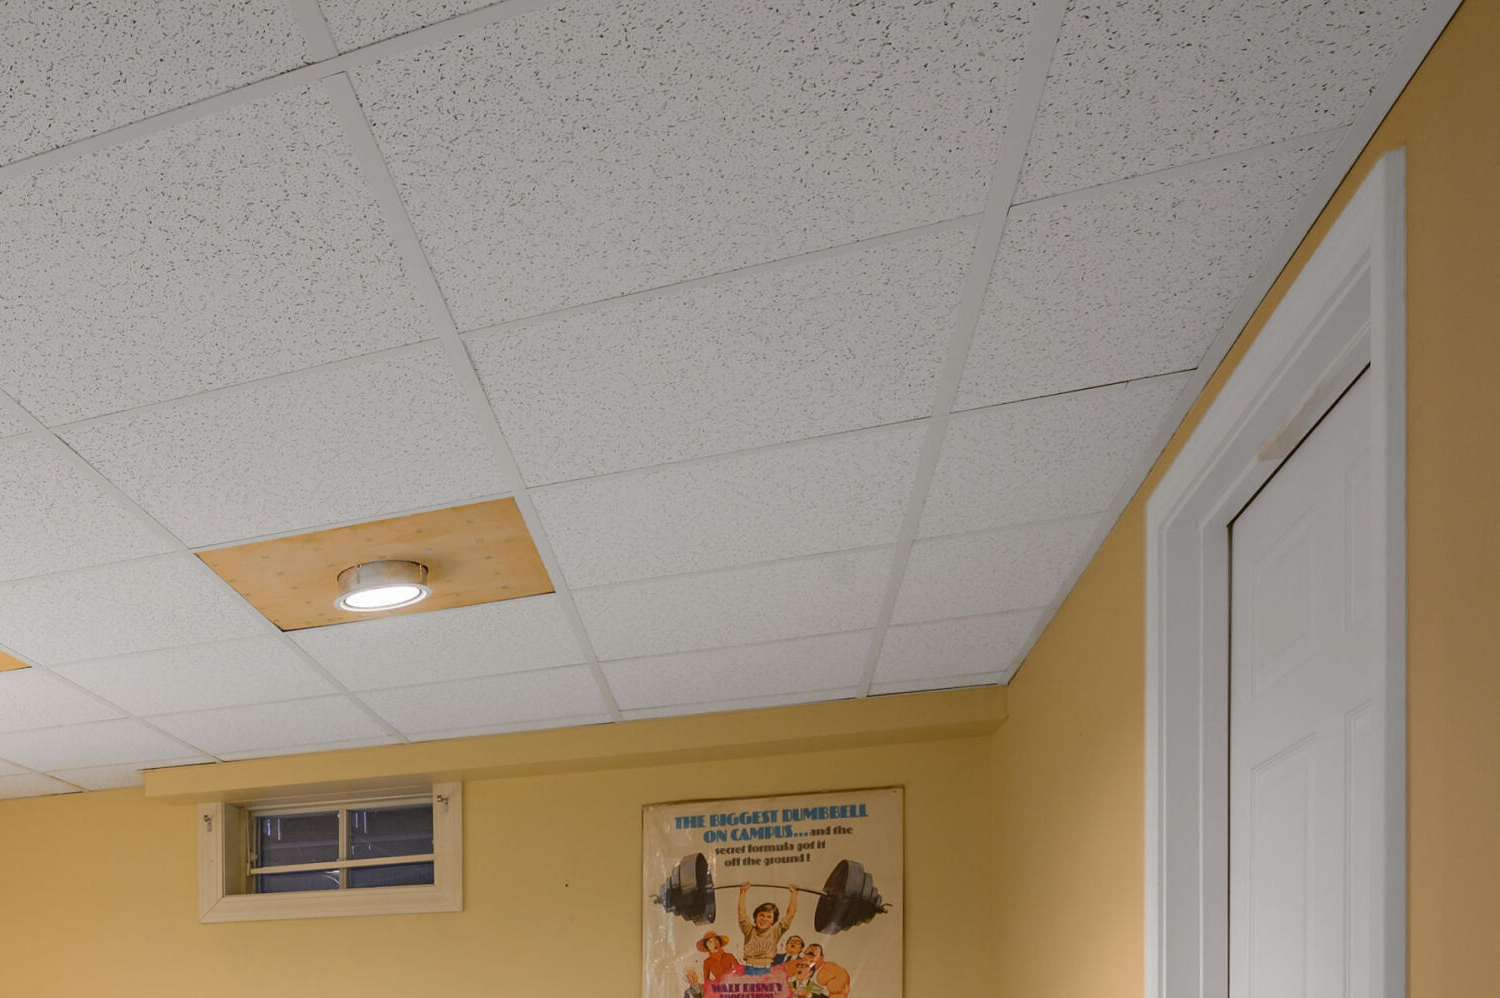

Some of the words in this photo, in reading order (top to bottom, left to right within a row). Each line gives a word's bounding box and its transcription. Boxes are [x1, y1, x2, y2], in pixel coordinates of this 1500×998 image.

[675, 815, 705, 829] THE
[710, 810, 779, 827] BIGGEST
[782, 804, 868, 822] DUMBBELL
[703, 829, 727, 843] ON
[810, 826, 831, 836] and
[833, 825, 853, 834] the
[715, 844, 745, 855] secret
[748, 842, 794, 853] formula
[797, 841, 814, 851] got
[817, 840, 826, 849] it
[725, 857, 740, 867] off
[742, 856, 760, 866] the
[711, 983, 740, 992] WALT
[743, 983, 783, 992] DISNEY
